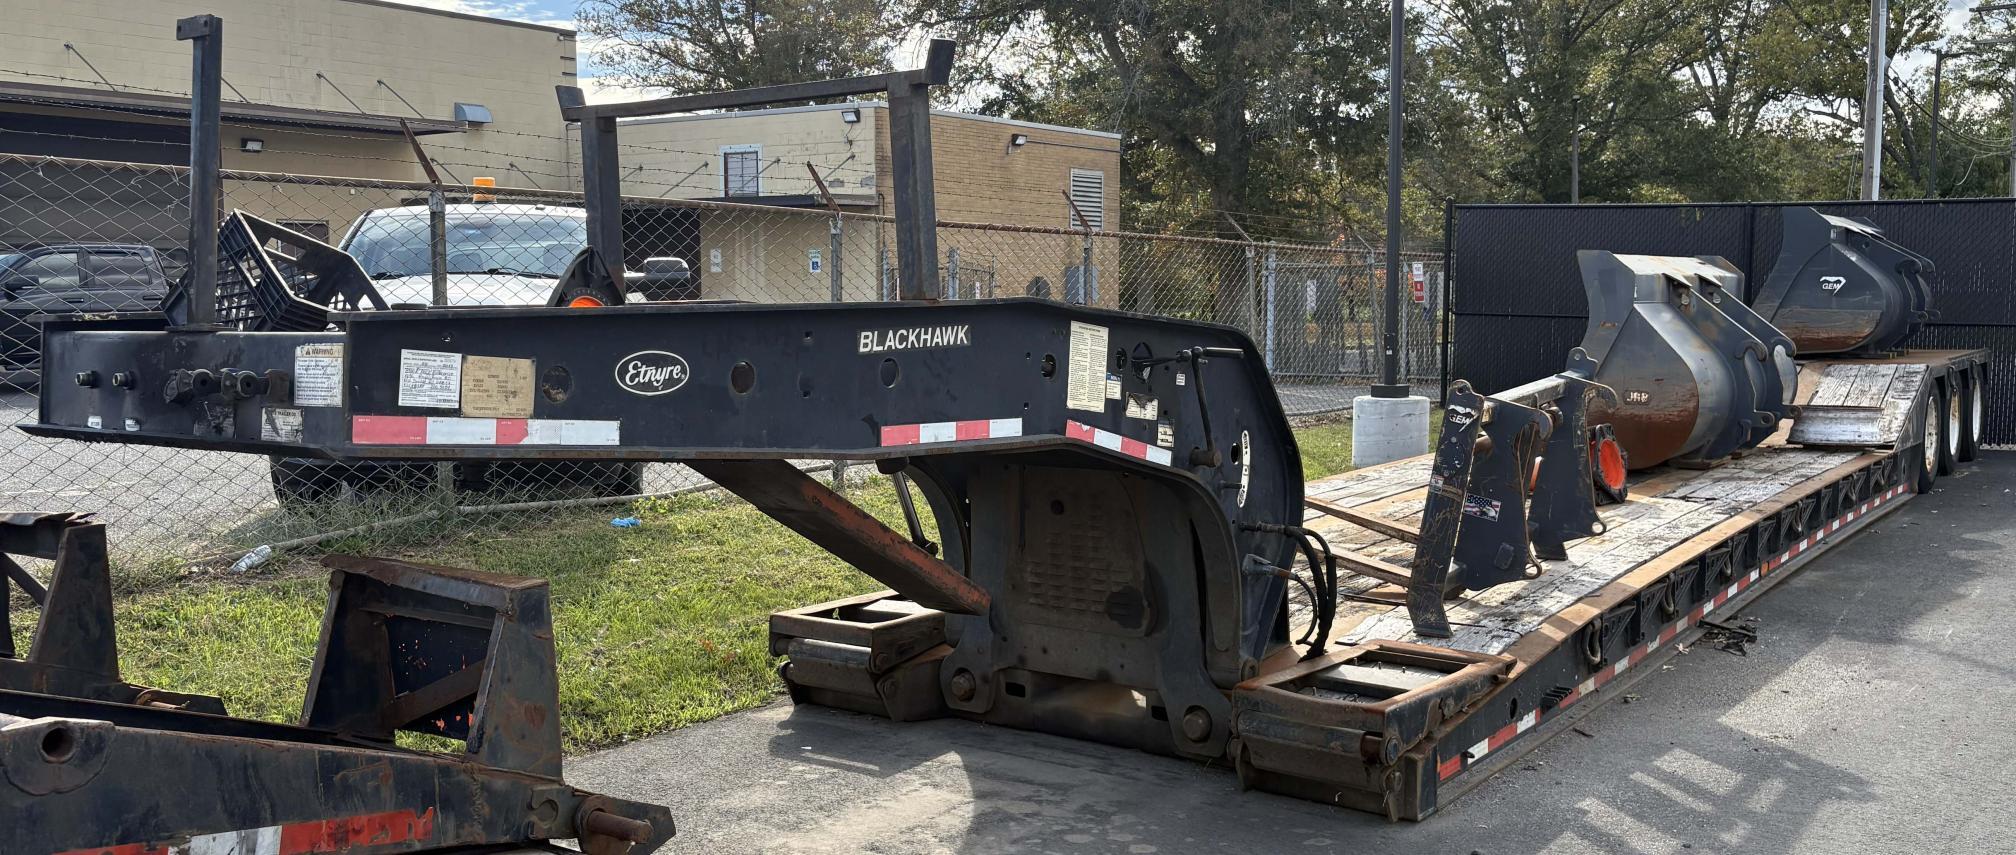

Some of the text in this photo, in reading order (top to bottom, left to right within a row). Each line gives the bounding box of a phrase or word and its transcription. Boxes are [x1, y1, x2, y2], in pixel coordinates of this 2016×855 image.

[859, 325, 969, 353] BLACKHAWK
[311, 346, 334, 356] WARNING
[625, 360, 682, 388] Etnyre
[1449, 413, 1473, 425] GEM
